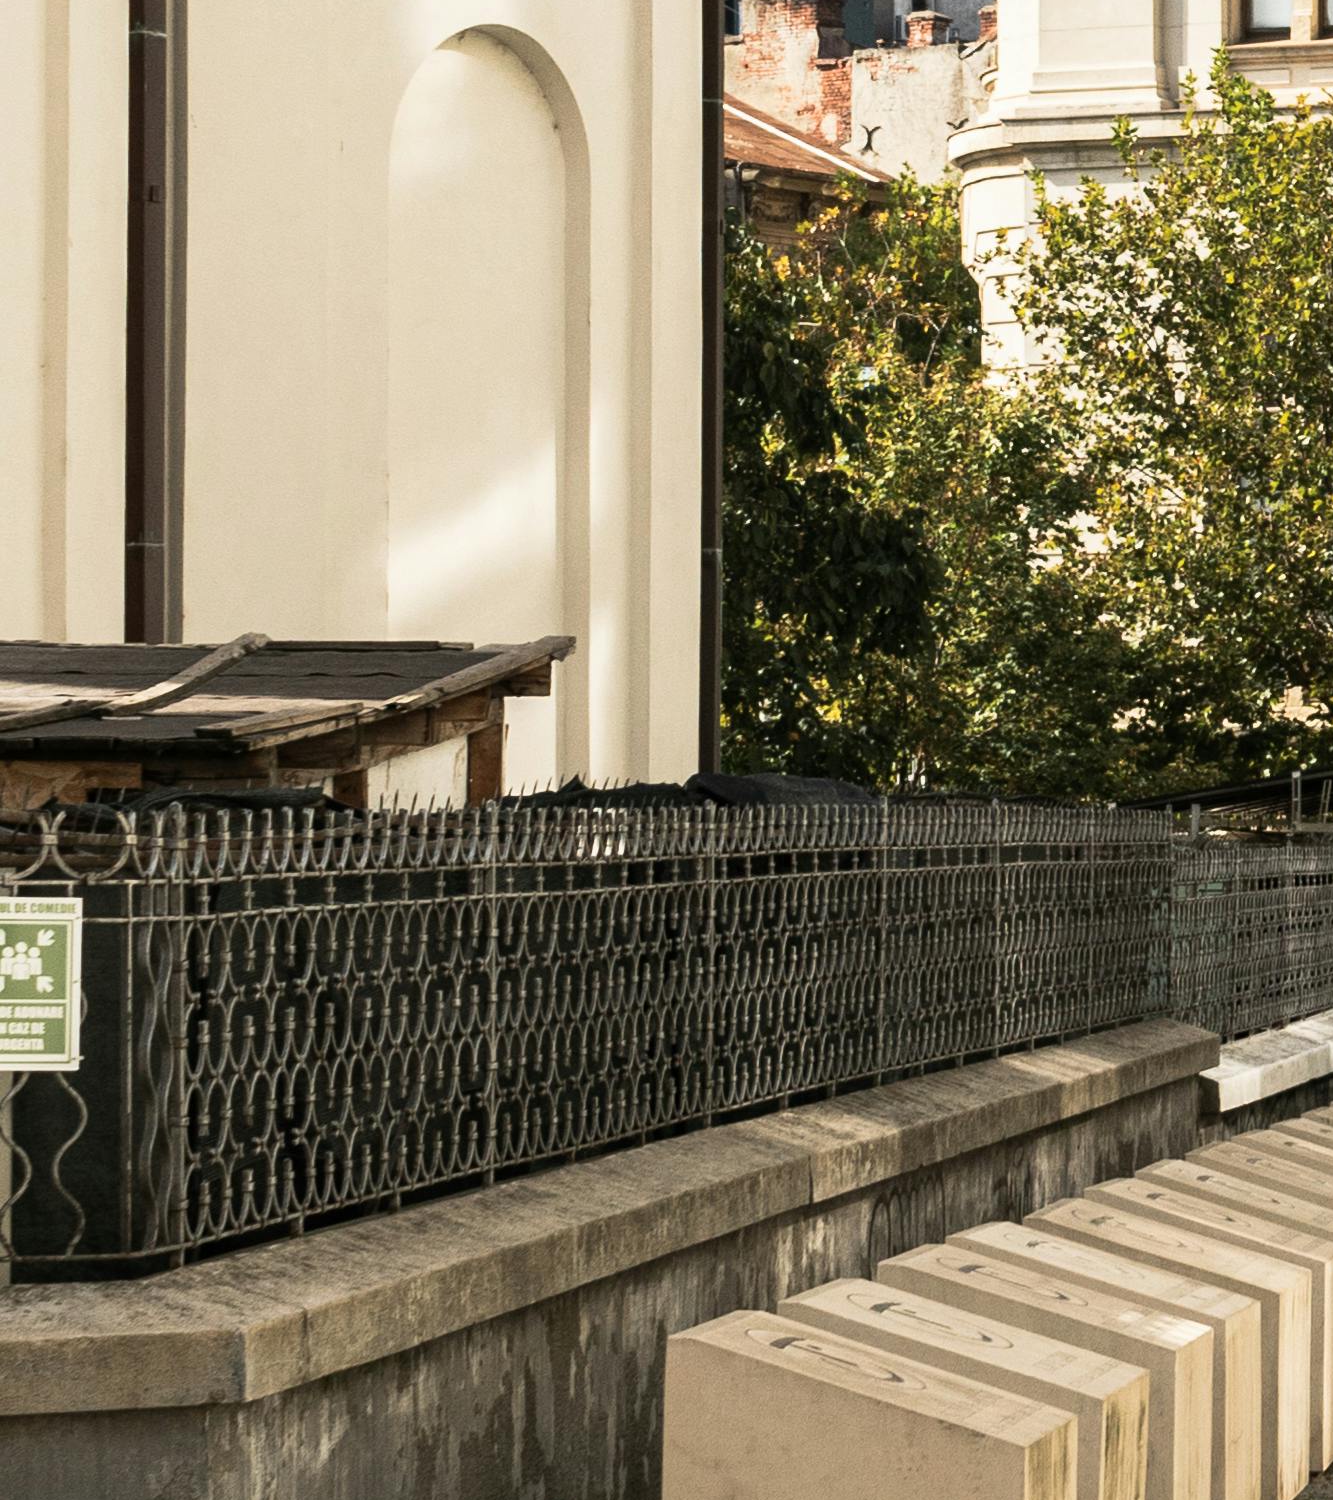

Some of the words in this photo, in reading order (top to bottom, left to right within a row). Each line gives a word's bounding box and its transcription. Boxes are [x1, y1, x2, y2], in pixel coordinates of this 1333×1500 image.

[15, 903, 27, 914] DE
[31, 903, 77, 914] COMEDIE
[8, 1022, 30, 1034] CAZ
[31, 1022, 46, 1034] DE
